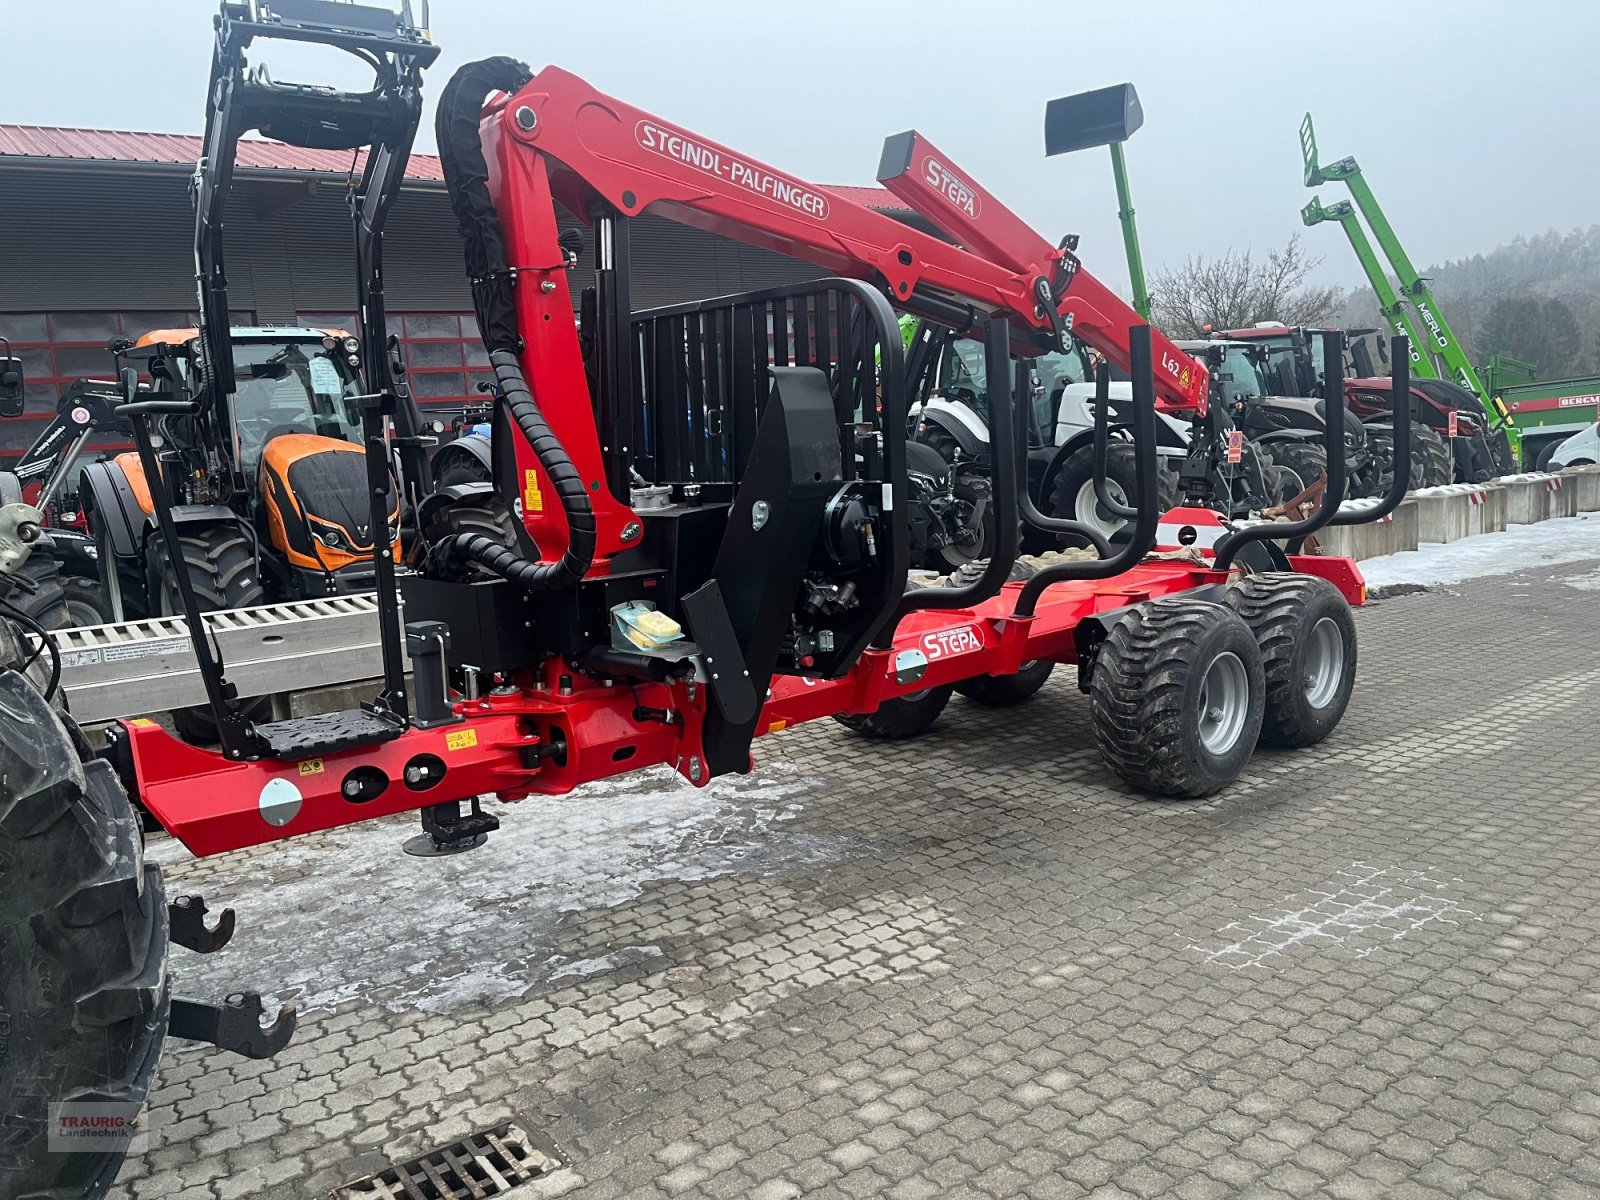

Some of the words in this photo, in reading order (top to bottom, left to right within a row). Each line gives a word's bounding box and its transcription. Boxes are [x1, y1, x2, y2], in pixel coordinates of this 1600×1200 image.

[642, 125, 825, 217] STEINDL-PALFINGER
[926, 159, 975, 217] STEPA
[1417, 302, 1448, 348] MERLO
[1161, 351, 1180, 378] L62
[923, 630, 981, 659] STEPA
